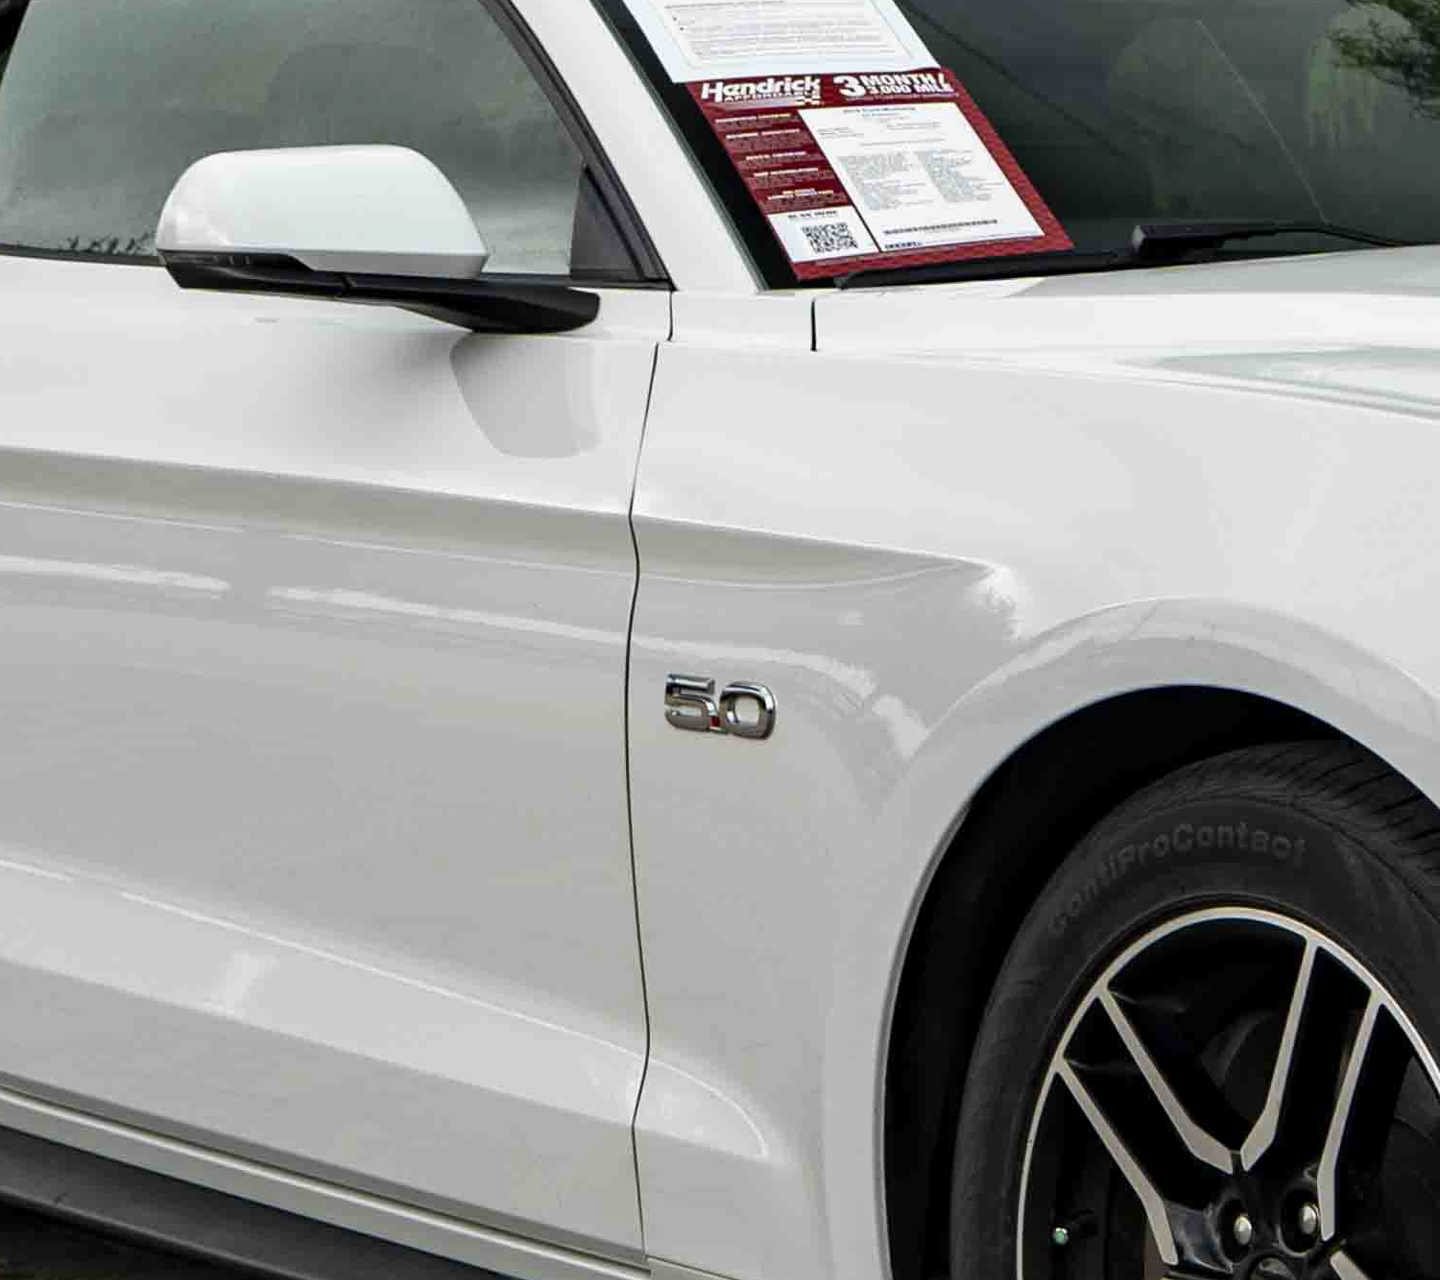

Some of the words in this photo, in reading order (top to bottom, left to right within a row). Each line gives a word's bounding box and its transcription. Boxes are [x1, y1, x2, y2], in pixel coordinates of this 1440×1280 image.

[701, 76, 821, 103] Hendrick
[833, 75, 866, 97] 3
[664, 673, 777, 740] 5.0
